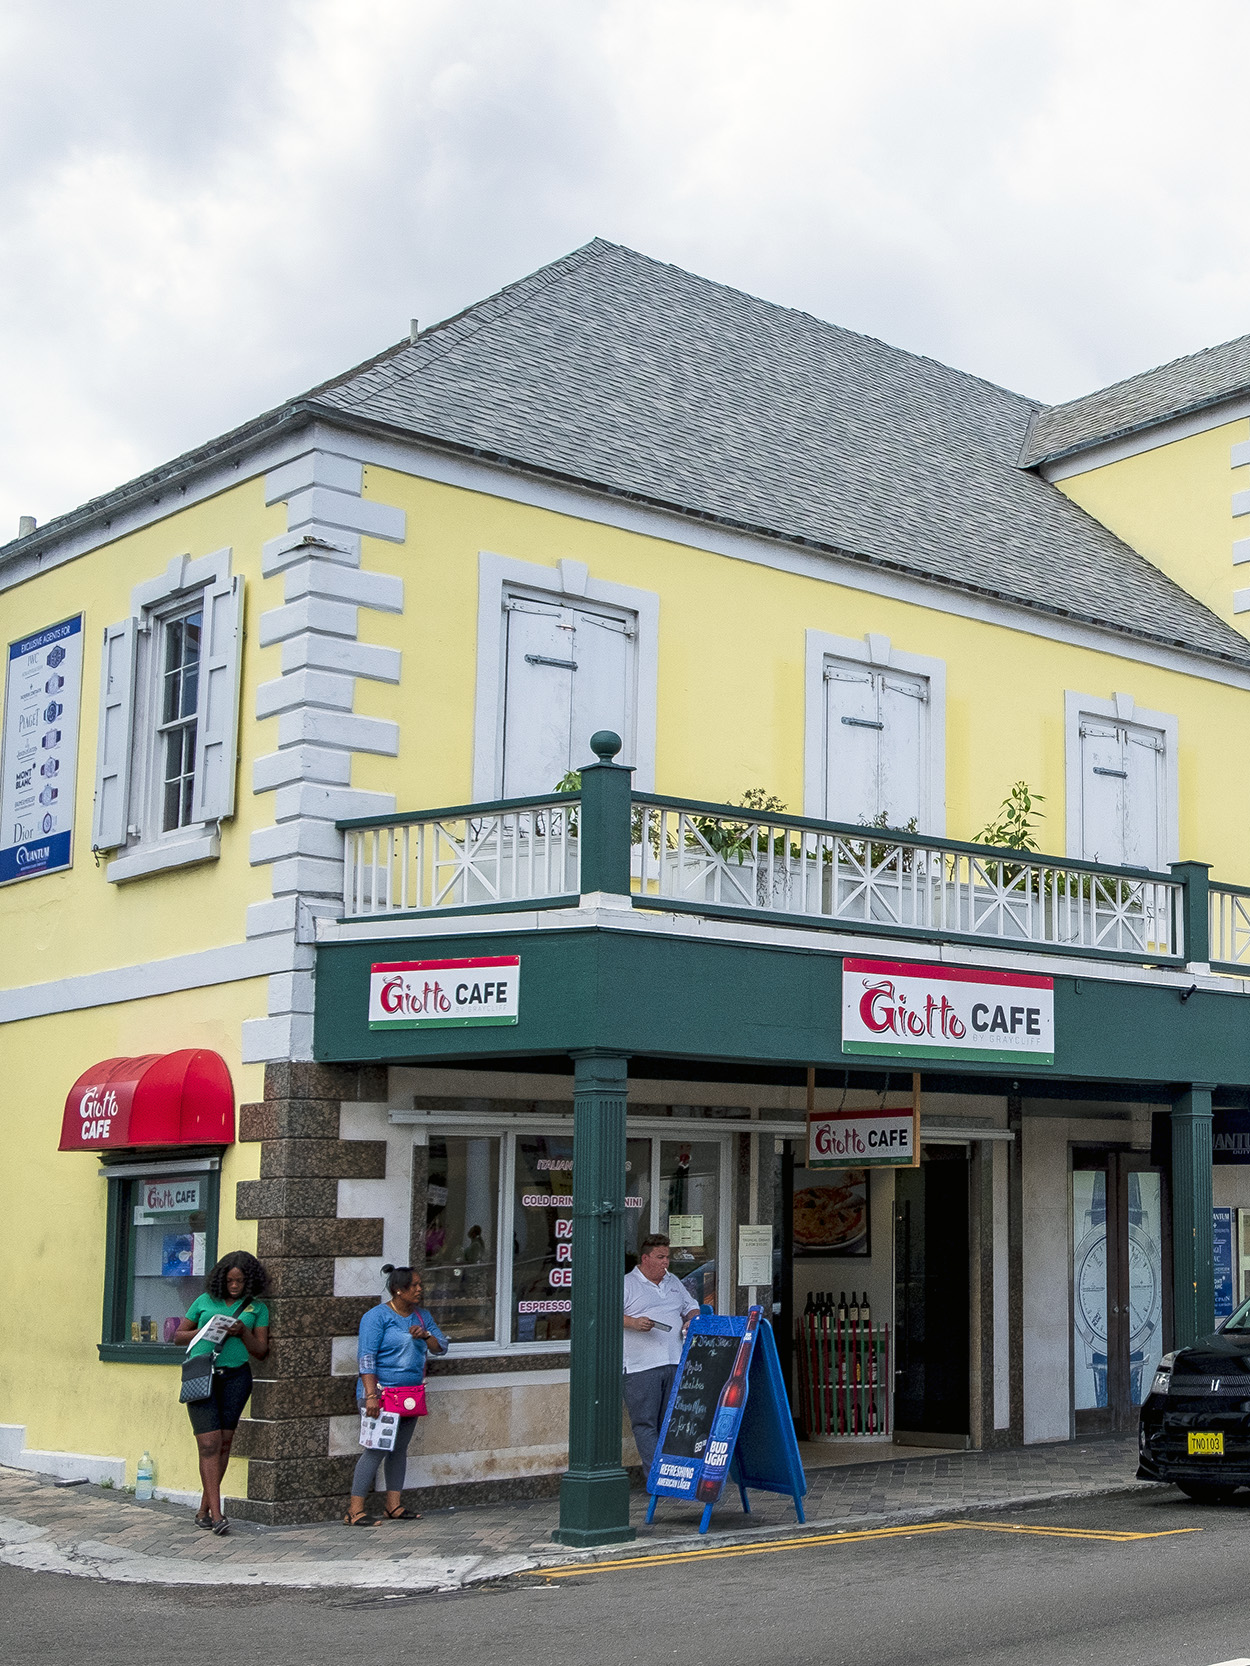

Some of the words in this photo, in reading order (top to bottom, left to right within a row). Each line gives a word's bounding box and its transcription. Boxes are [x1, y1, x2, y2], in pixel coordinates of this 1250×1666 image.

[21, 636, 42, 653] EXCLUSIVE
[42, 629, 60, 643] AGENTS
[60, 625, 71, 637] FOR
[19, 708, 40, 732] PIAGET
[16, 768, 32, 781] MONT
[16, 777, 32, 789] BLANC
[13, 823, 33, 843] Dior
[380, 975, 451, 1015] Giotto
[455, 982, 508, 1005] CAFE
[859, 978, 966, 1039] Giotto
[971, 1003, 1041, 1035] CAFE
[972, 1034, 985, 1042] BY
[989, 1035, 1041, 1045] GRAYCLIFF
[80, 1087, 118, 1118] Giotto
[81, 1119, 111, 1140] CAFE
[815, 1124, 866, 1154] Giotto
[868, 1129, 908, 1148] CAFE
[147, 1187, 174, 1209] Giotto
[175, 1190, 196, 1203] CAFE
[522, 1195, 549, 1207] COLD
[551, 1195, 573, 1207] DRIN
[625, 1197, 642, 1207] NINI
[519, 1300, 571, 1313] ESPRESSO
[710, 1441, 728, 1454] BUD
[704, 1452, 728, 1466] LIGHT
[660, 1463, 694, 1479] REFRESHING
[657, 1477, 677, 1488] AMERICAN
